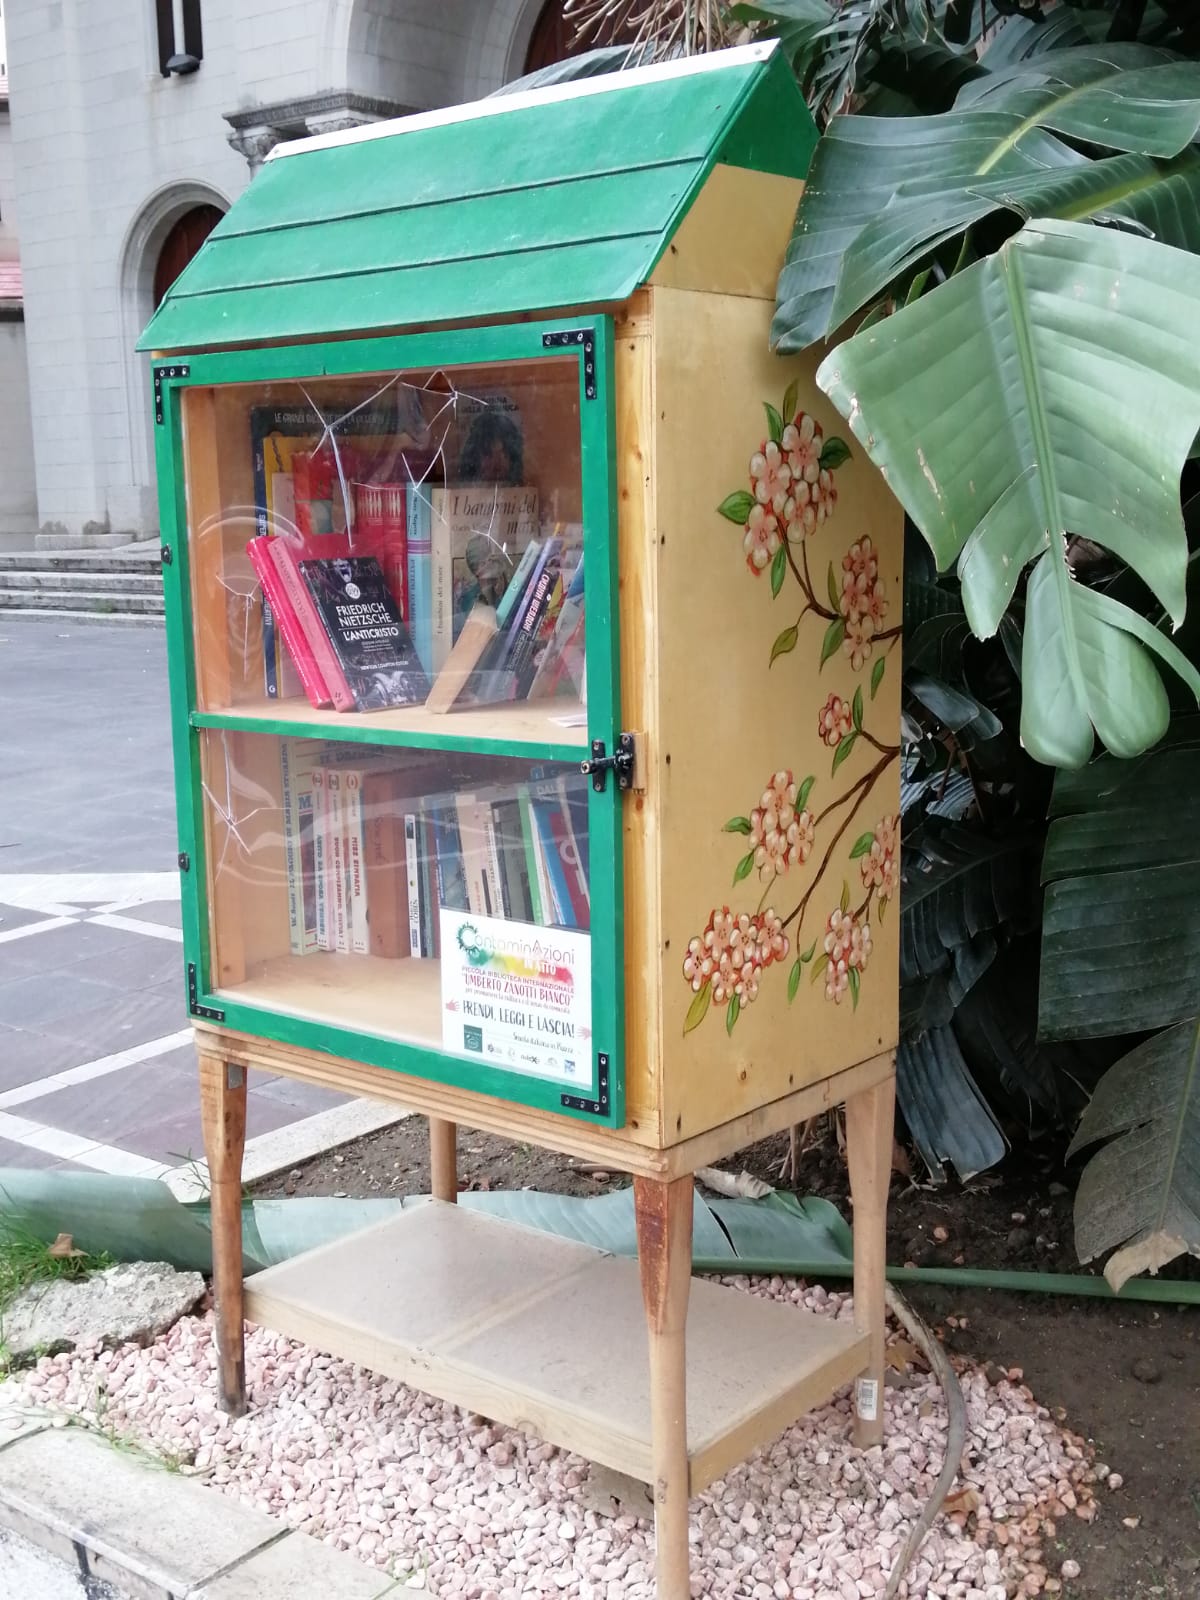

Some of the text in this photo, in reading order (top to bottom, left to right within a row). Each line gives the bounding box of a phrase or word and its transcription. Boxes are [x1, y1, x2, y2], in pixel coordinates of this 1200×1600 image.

[453, 496, 459, 516] I
[335, 602, 386, 616] FRIEDRICH
[338, 612, 393, 627] NIETZSCHE
[343, 626, 399, 641] L'ANTICRISTO
[462, 966, 575, 994] PICCOLA BIBLIOTECA INTERNAZIONALE
[504, 981, 537, 1000] ZANOTTI
[463, 1000, 575, 1039] PRENDI, LEGGI E LASCIA!
